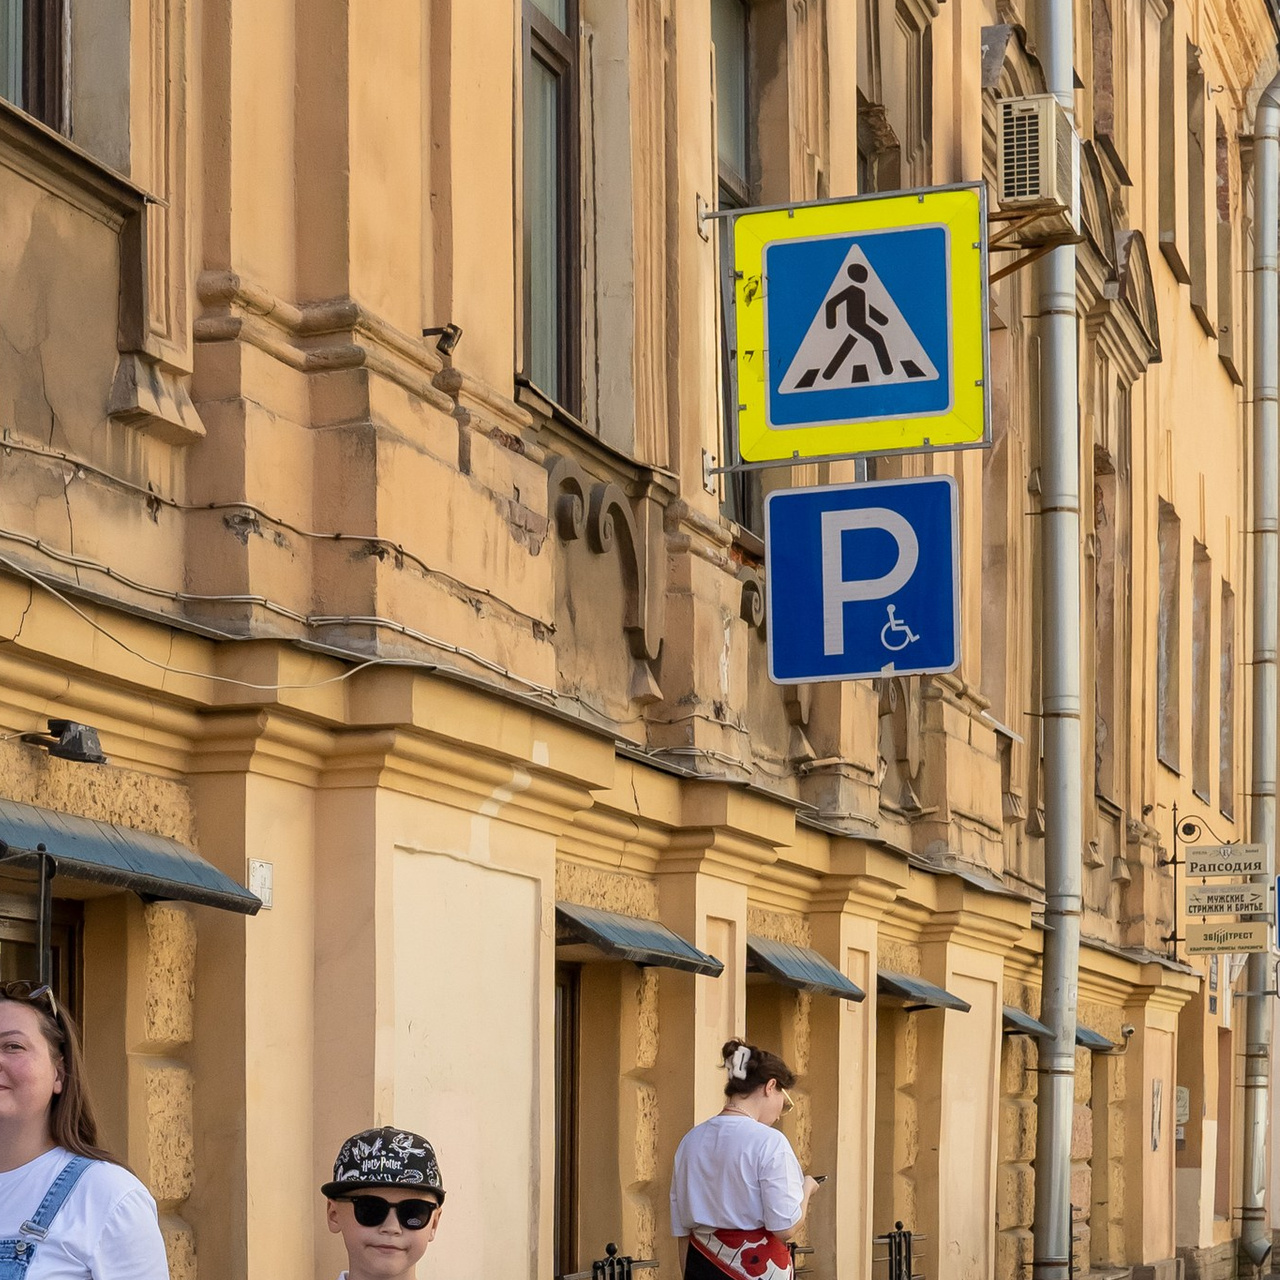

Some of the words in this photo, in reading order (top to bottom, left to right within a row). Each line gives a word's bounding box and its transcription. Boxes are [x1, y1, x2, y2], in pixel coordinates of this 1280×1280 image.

[821, 507, 919, 656] P
[1190, 861, 1262, 873] Рапсодия
[1207, 894, 1244, 903] МУЖСКИЕ
[1188, 904, 1224, 913] СТРИЖКИ
[1227, 904, 1232, 912] И
[1235, 903, 1263, 911] БРИТЬЕ
[361, 1158, 380, 1172] Harry
[380, 1156, 402, 1172] Potter
